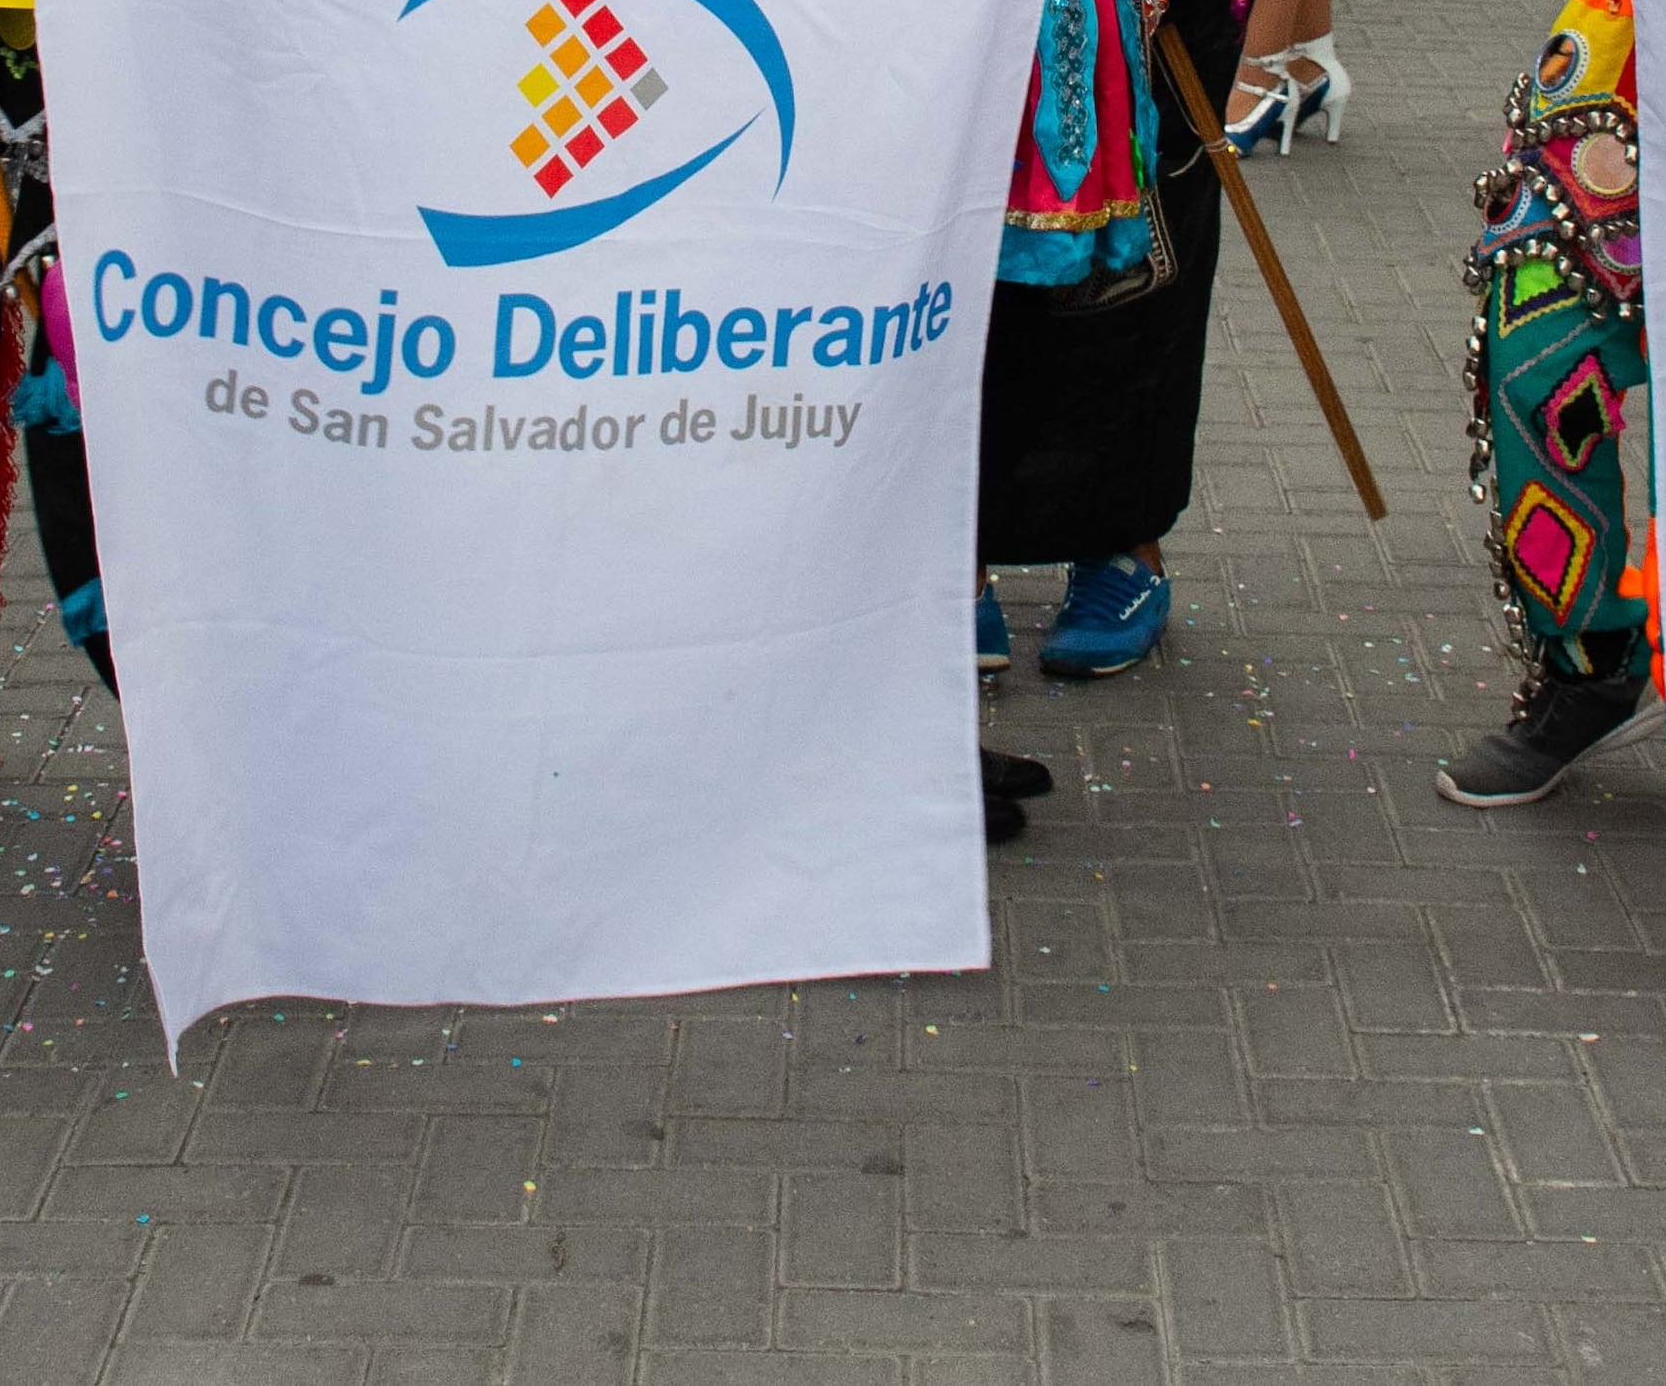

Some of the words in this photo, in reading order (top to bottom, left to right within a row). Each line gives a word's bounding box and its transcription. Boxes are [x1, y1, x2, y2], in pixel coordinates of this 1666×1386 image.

[92, 249, 457, 395] Concejo
[491, 278, 954, 380] Deliberante
[205, 368, 271, 421] de
[288, 389, 390, 451] San
[410, 401, 647, 454] Salvador
[659, 401, 717, 446] de
[729, 393, 864, 449] Jujuy
